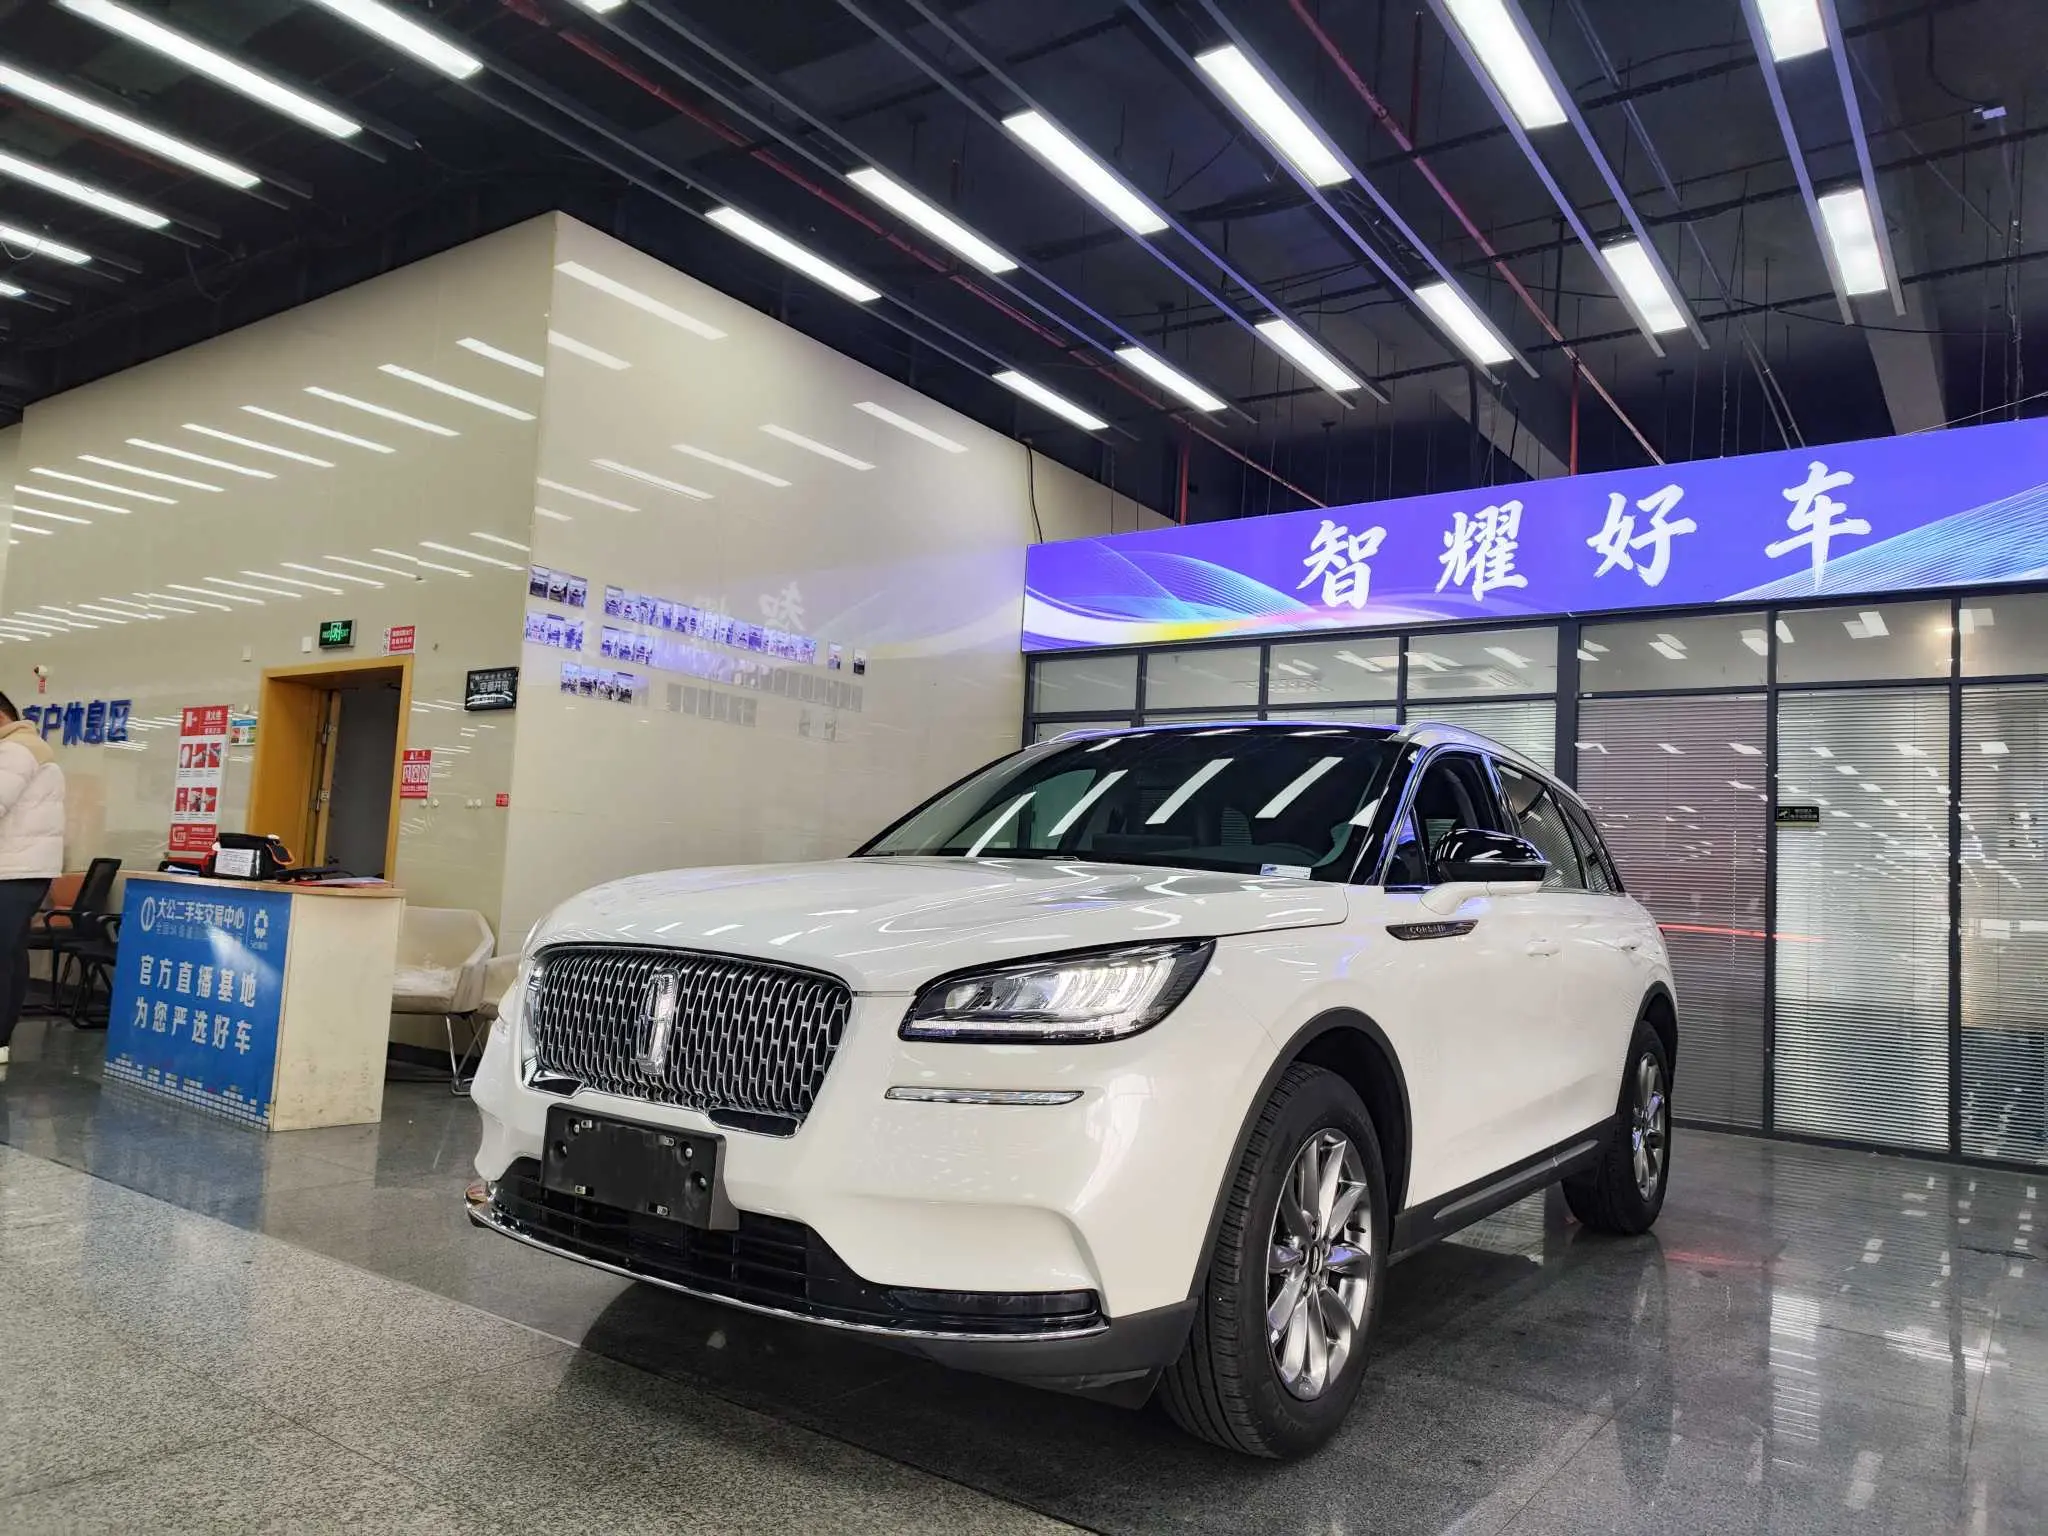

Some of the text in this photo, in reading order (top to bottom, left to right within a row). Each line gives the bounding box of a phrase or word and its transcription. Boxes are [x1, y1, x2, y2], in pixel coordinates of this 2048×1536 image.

[1297, 461, 1872, 609] 智耀好车
[139, 954, 257, 1008] 官方直播基地
[133, 996, 253, 1056] 为您严选好车
